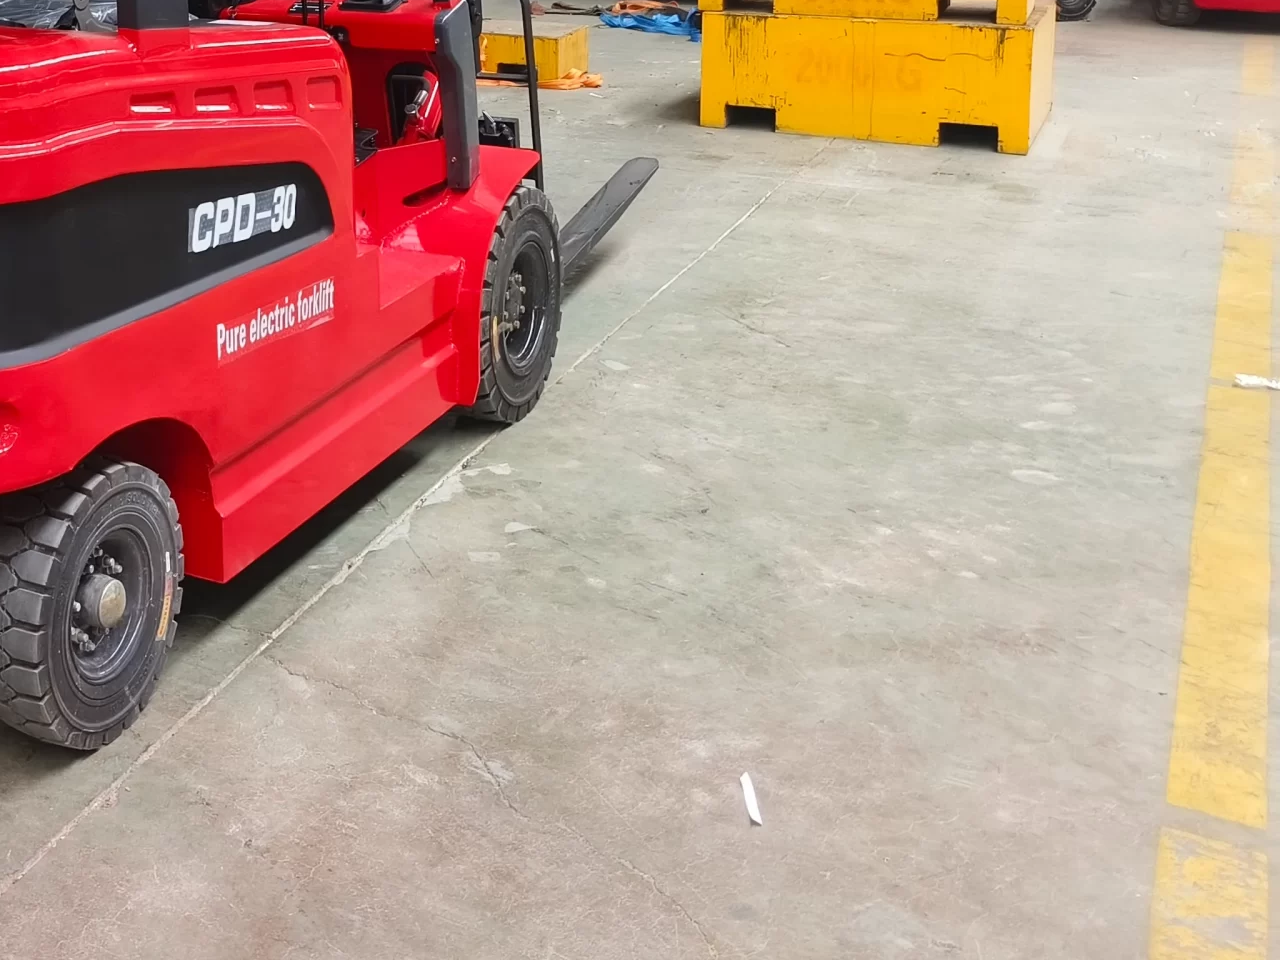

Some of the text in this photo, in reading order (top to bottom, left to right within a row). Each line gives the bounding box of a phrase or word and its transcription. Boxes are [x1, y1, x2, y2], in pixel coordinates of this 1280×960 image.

[192, 183, 297, 253] CPD-30
[217, 279, 335, 360] Pure electric forklift
